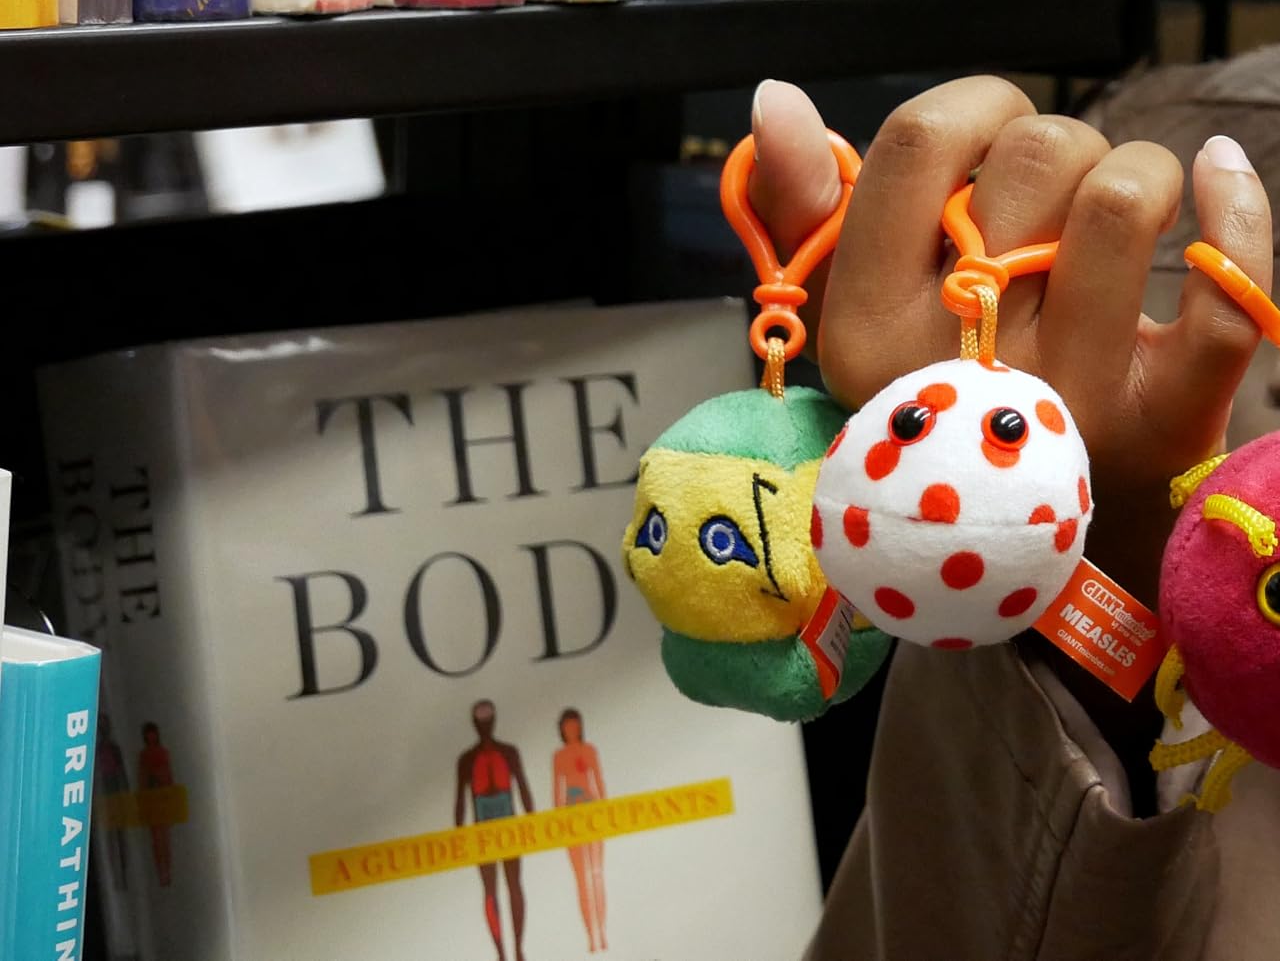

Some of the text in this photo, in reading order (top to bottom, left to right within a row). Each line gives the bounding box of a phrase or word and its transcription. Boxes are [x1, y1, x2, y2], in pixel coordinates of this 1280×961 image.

[315, 370, 640, 517] THE
[110, 466, 162, 623] THE
[273, 538, 619, 701] BOD
[1060, 603, 1136, 668] MEASLES
[331, 788, 721, 887] A GUIDE FOR OCCUPANTS
